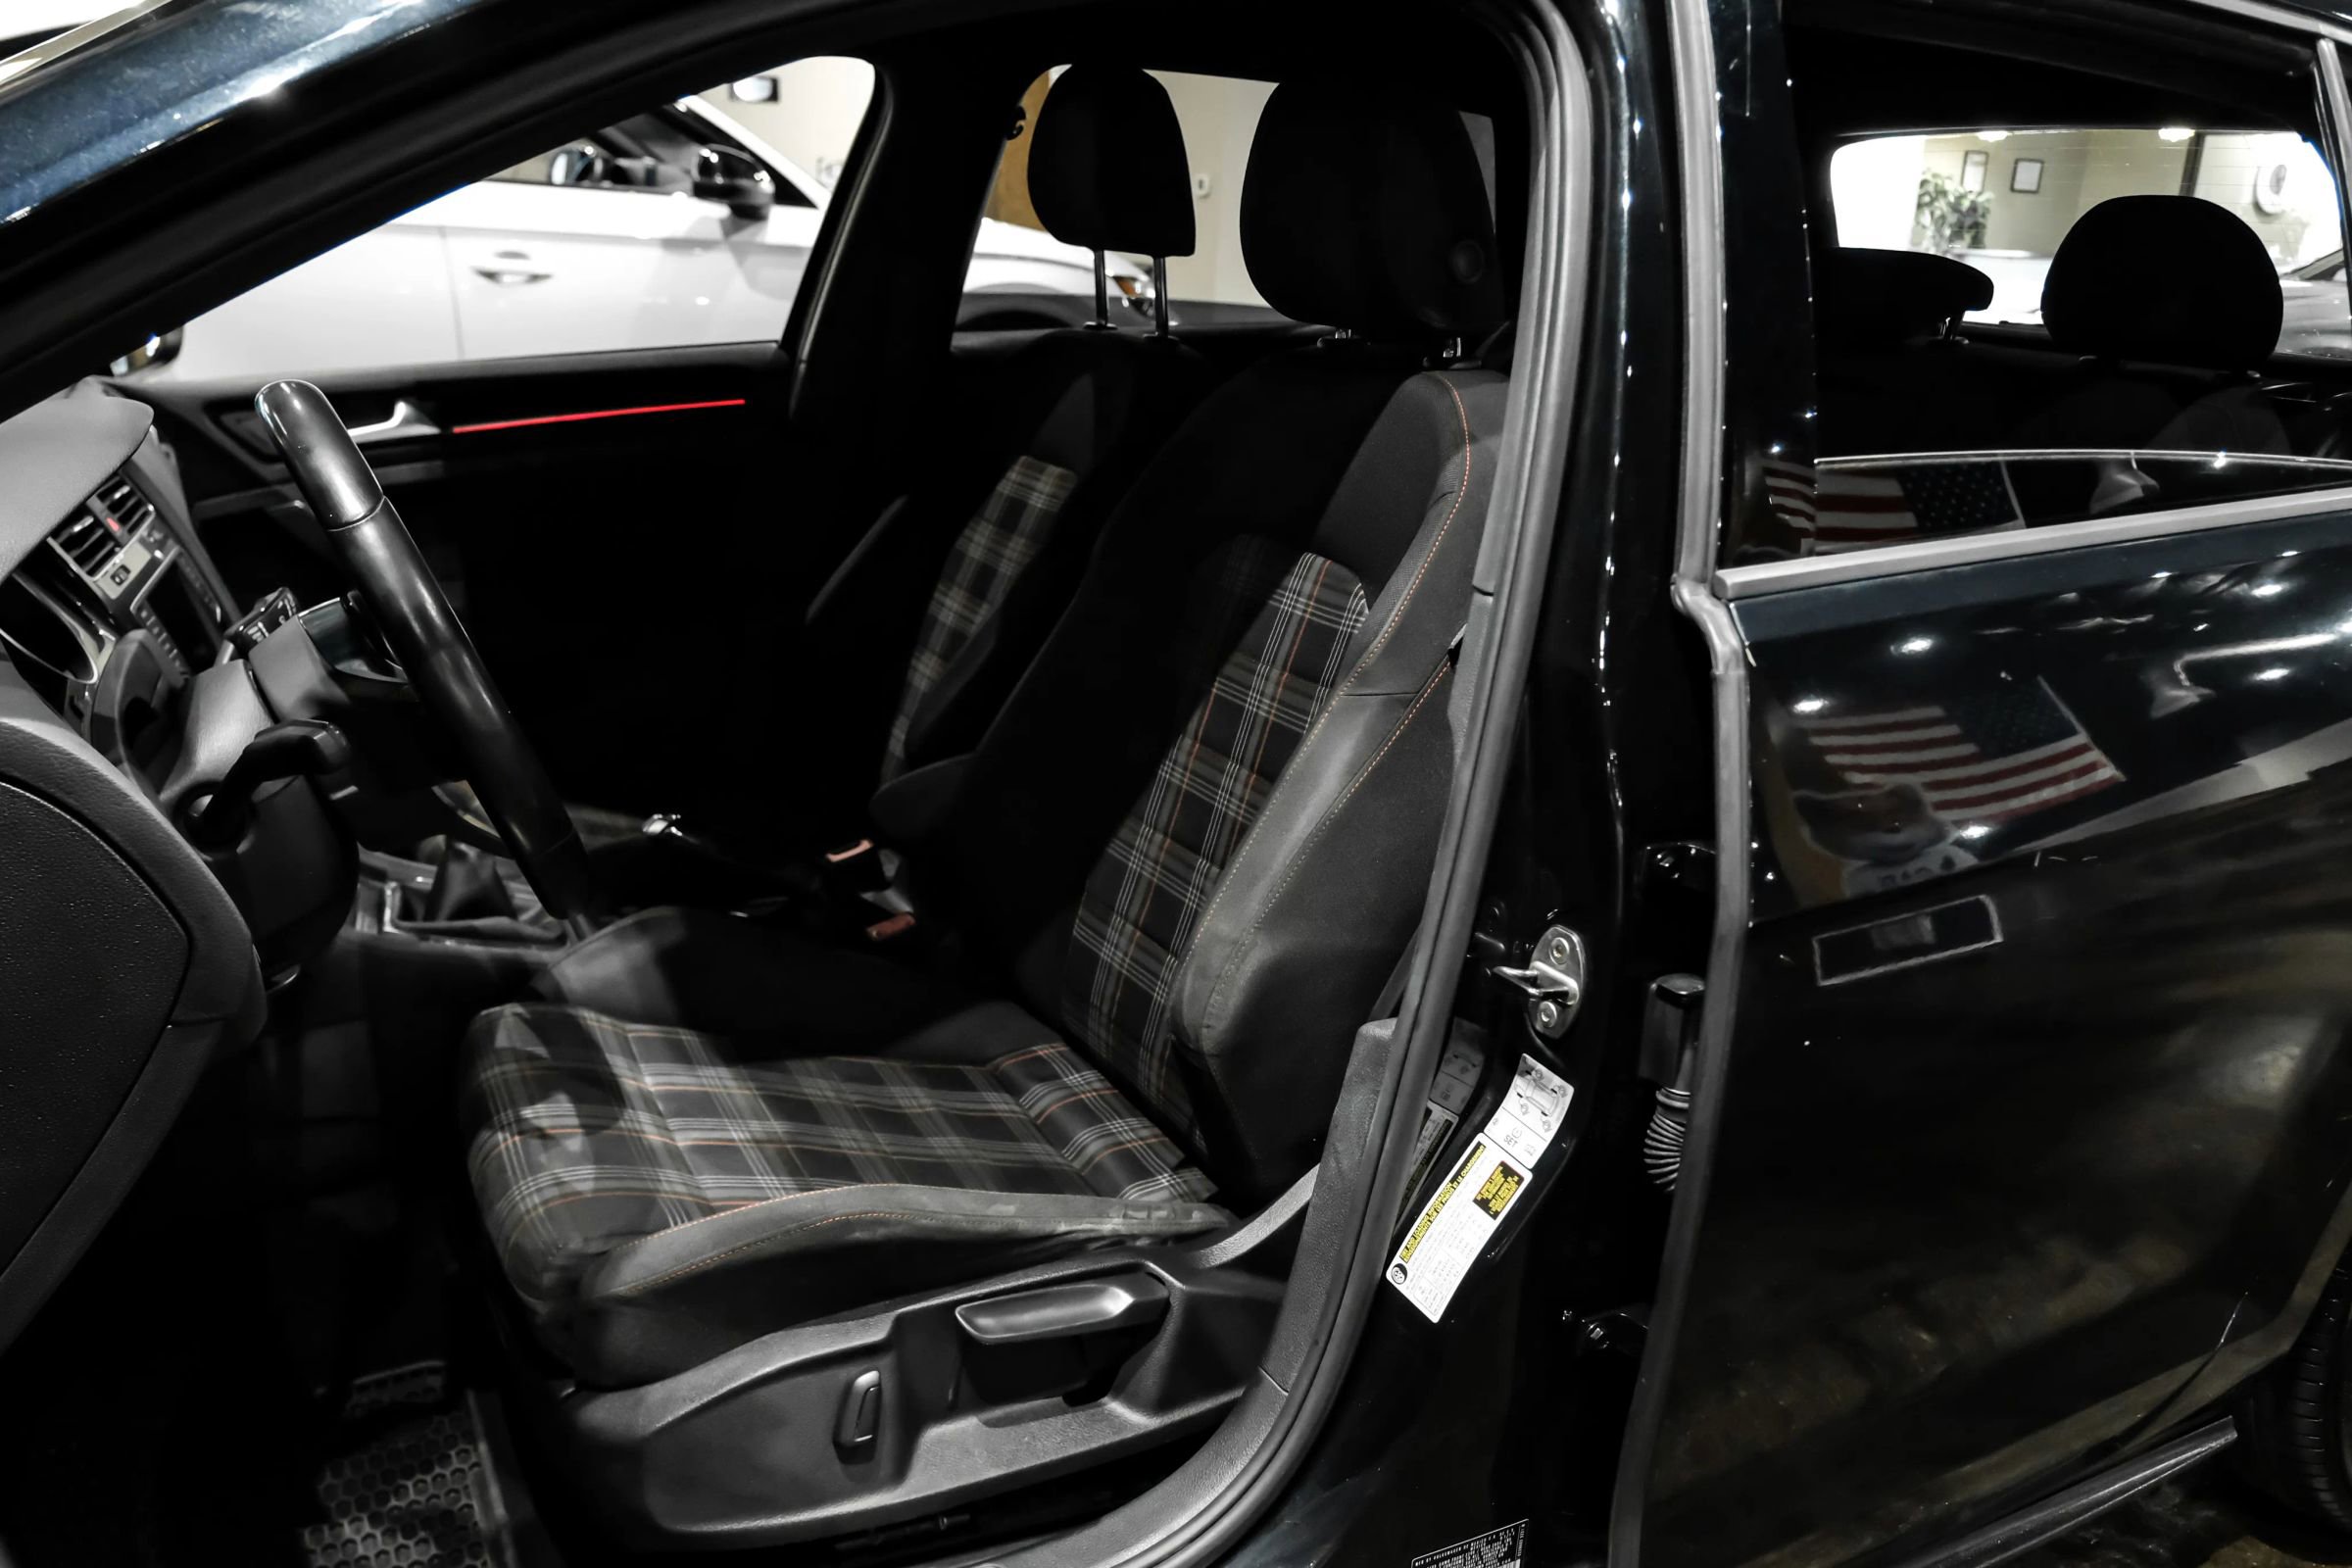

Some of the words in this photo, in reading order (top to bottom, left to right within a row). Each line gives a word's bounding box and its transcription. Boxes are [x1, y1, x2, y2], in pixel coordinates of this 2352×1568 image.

[1502, 1134, 1518, 1148] SET
[1459, 1145, 1485, 1177] CHARGEMENT
[1412, 1214, 1429, 1238] LOADING
[1427, 1182, 1452, 1215] INFORMATION
